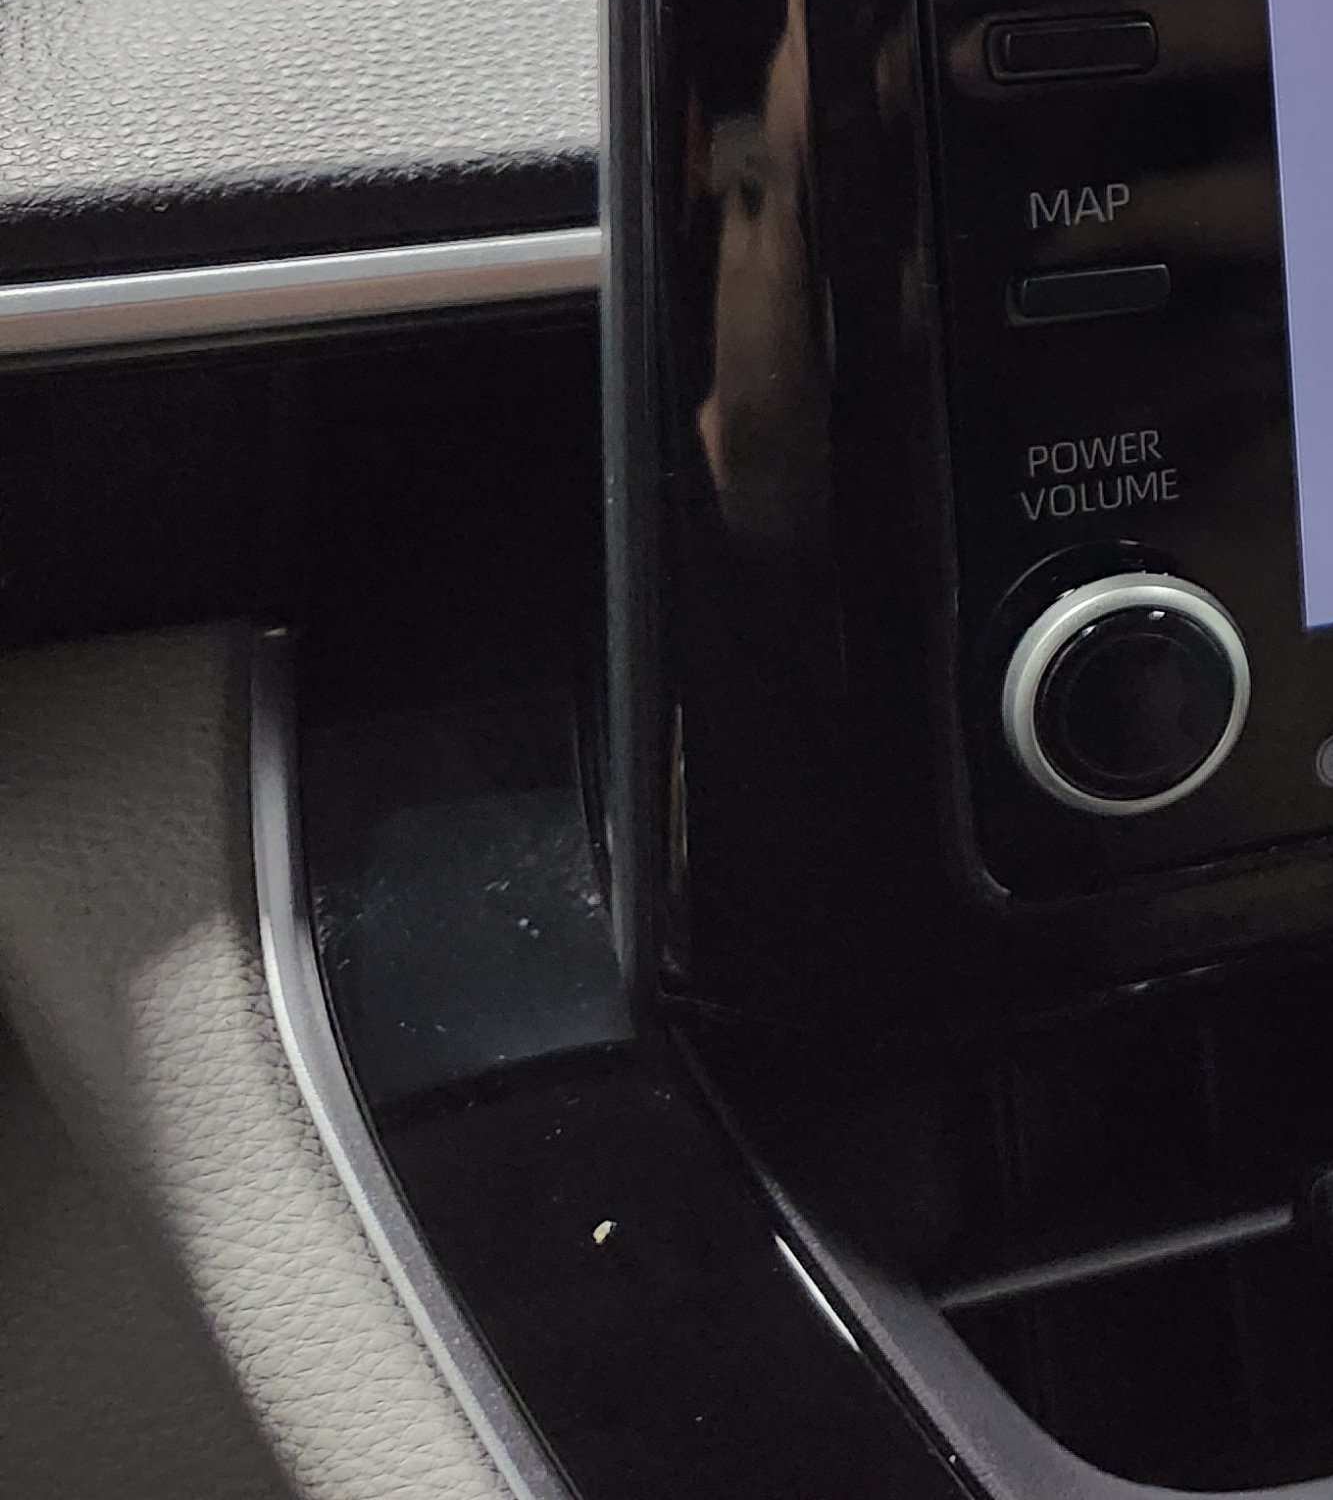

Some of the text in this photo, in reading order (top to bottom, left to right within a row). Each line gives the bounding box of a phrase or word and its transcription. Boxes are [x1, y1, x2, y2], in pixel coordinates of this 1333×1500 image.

[1028, 183, 1131, 229] MAP
[1027, 429, 1164, 477] POWER
[1019, 468, 1181, 521] VOLUME
